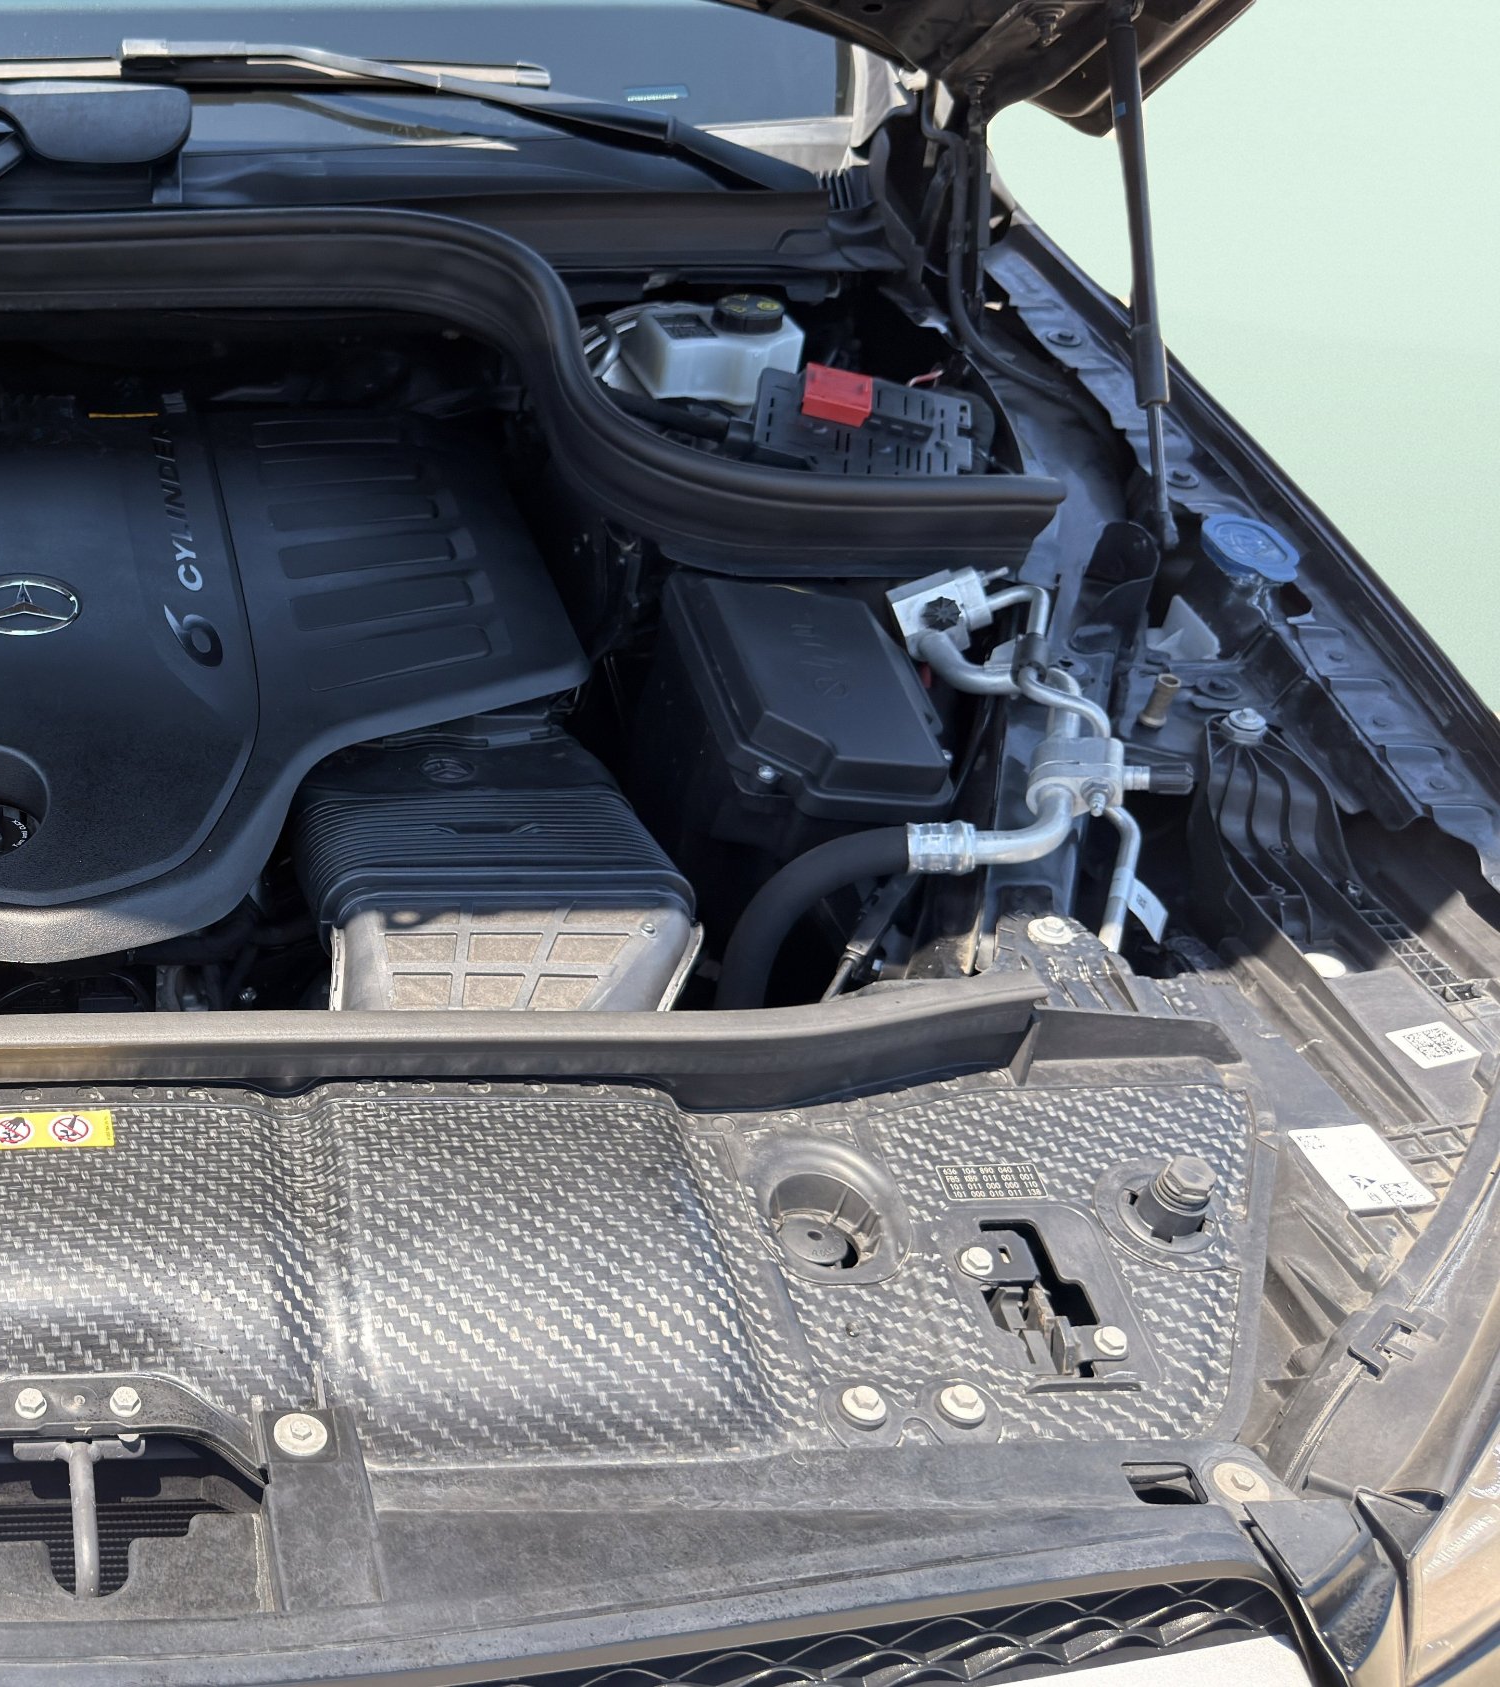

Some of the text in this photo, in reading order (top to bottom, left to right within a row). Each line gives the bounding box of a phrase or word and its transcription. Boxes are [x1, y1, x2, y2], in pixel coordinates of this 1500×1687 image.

[151, 423, 224, 668] 6 CYLINDER
[998, 1166, 1012, 1174] 040
[968, 1182, 982, 1190] 011
[971, 1190, 986, 1198] 000
[1008, 1189, 1023, 1197] 011
